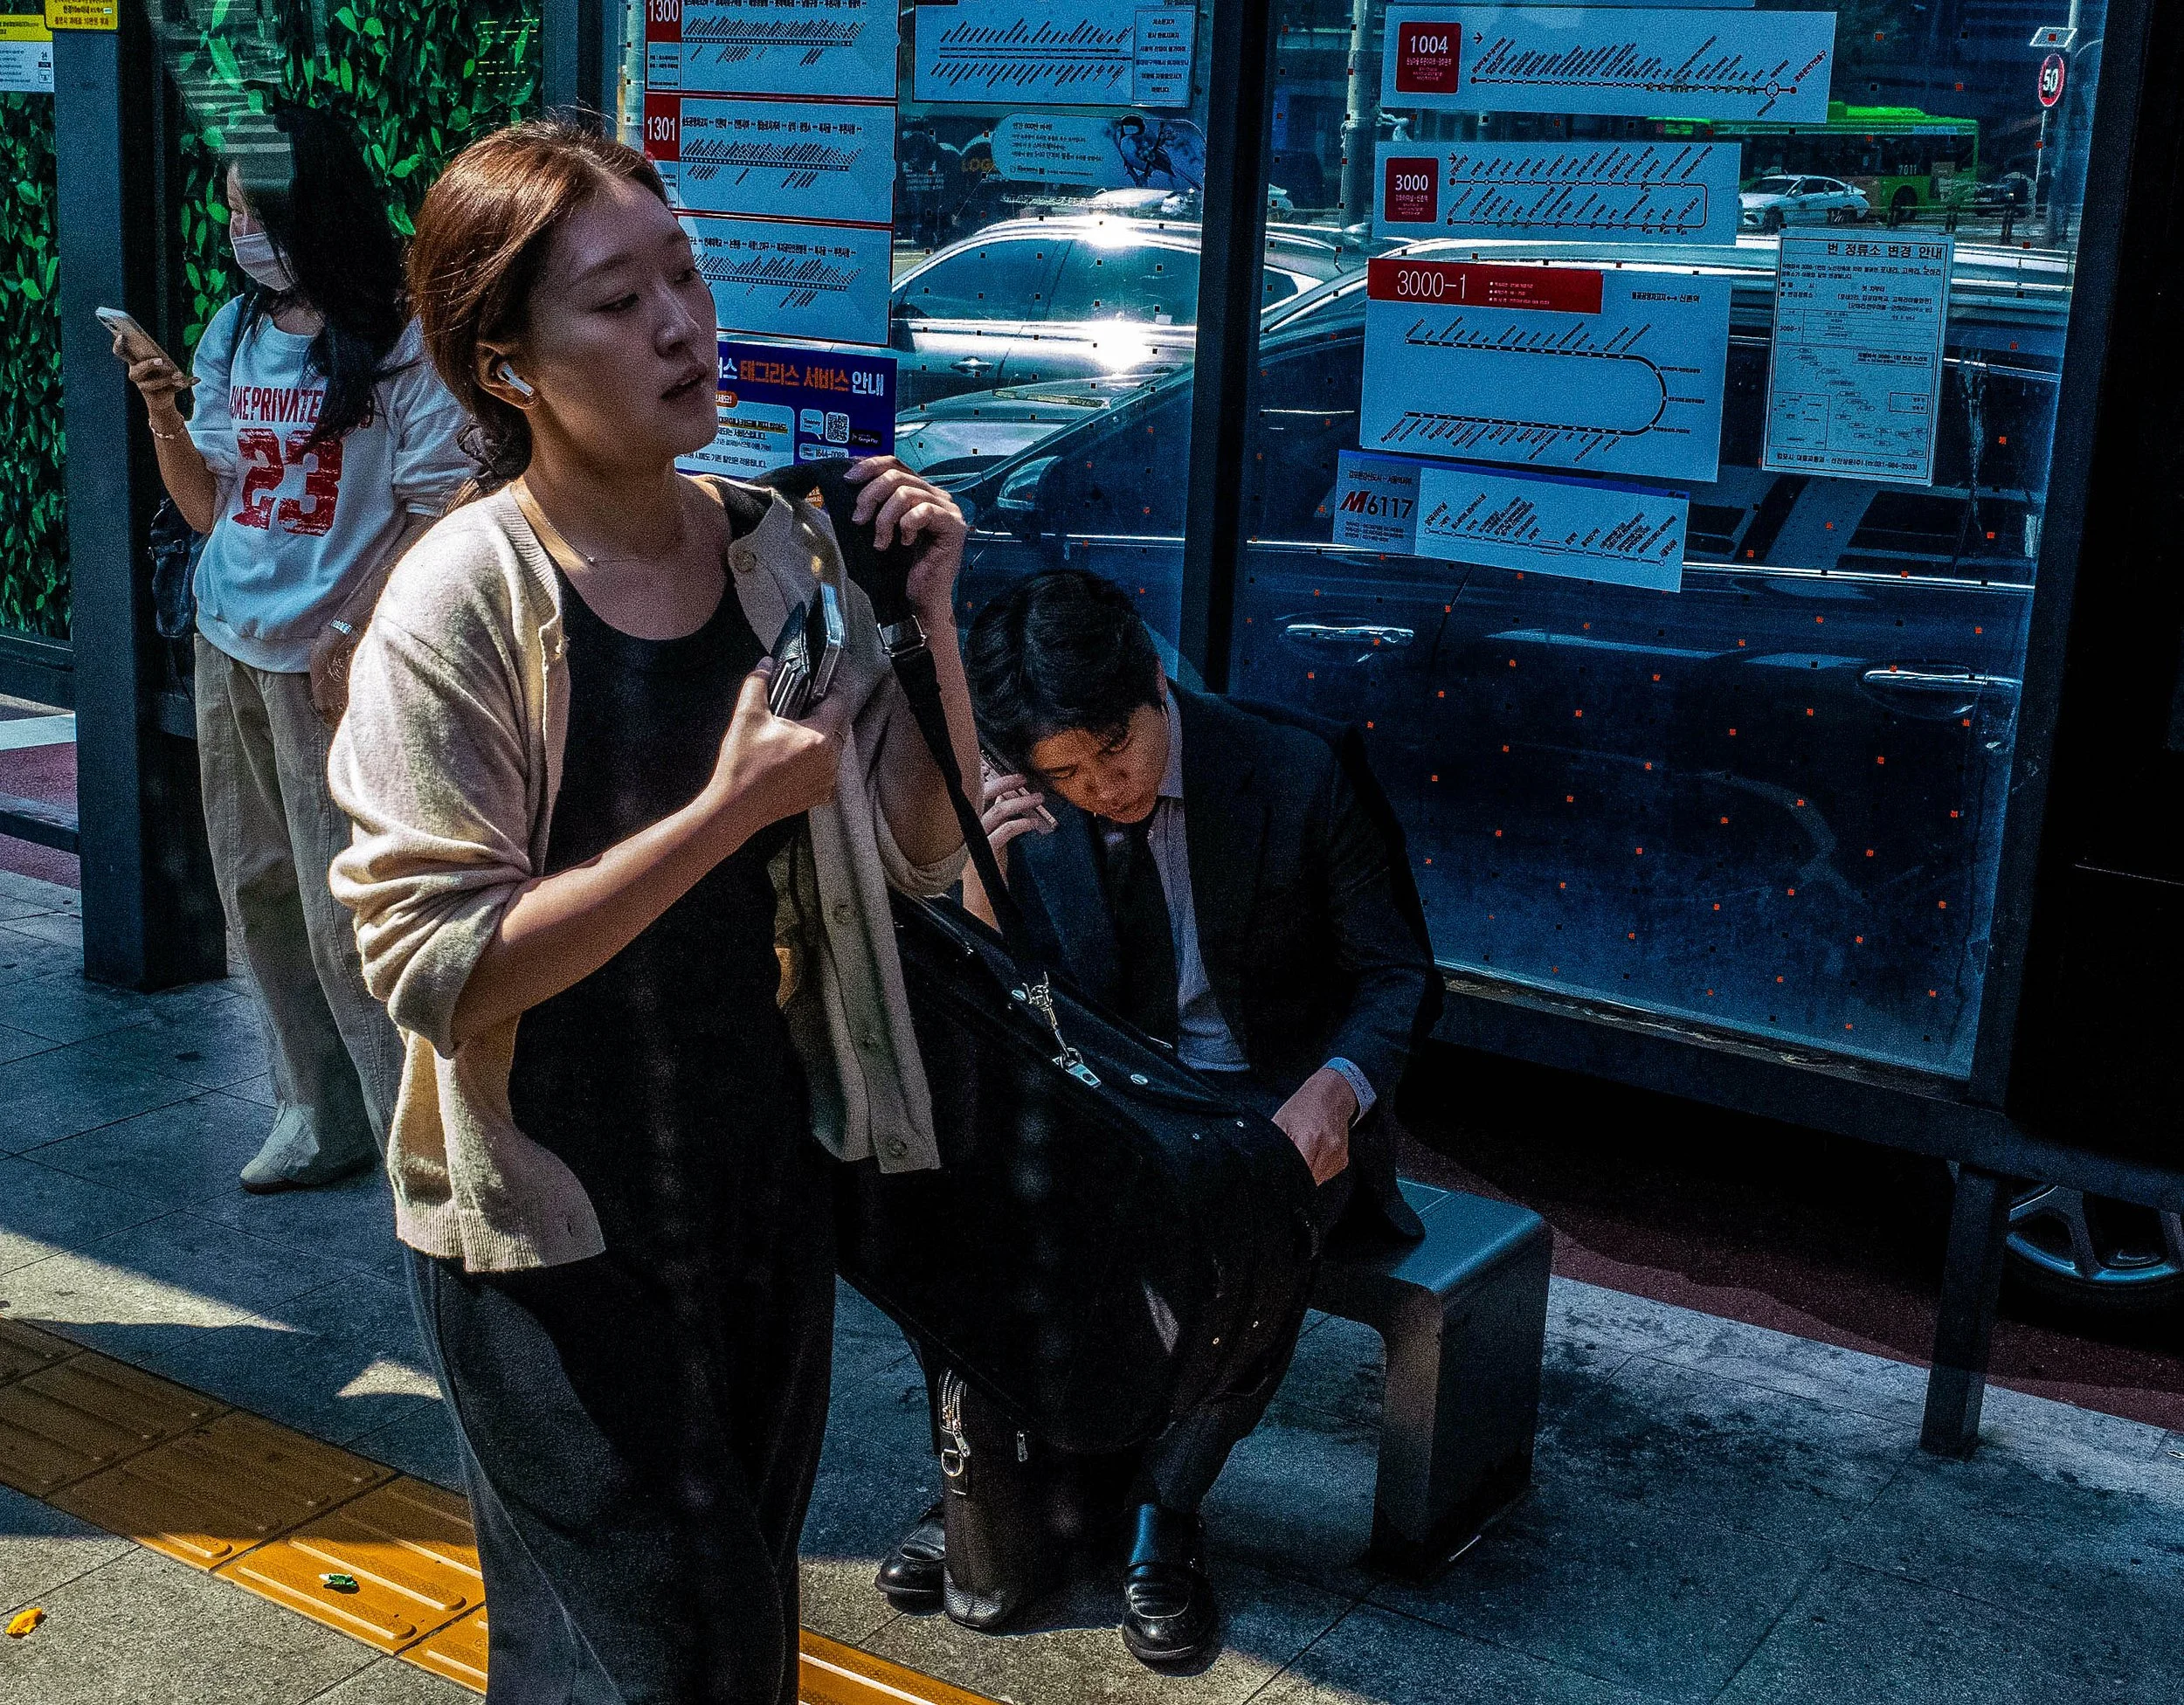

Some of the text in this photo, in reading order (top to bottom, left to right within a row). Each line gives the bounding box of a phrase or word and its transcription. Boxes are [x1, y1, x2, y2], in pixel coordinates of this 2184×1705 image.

[649, 0, 679, 22] 1300
[1410, 35, 1448, 54] 1004
[2042, 68, 2059, 93] 50
[647, 116, 675, 142] 1301
[1395, 174, 1429, 191] 3000
[1898, 164, 1917, 176] 7011
[1828, 242, 1943, 259] 번 정류소 변경 안내
[1397, 270, 1467, 299] 3000-1
[740, 359, 800, 387] 태그리스
[804, 366, 850, 392] 서비스
[852, 370, 884, 397] 안내
[232, 427, 343, 537] 23
[1339, 490, 1414, 520] M6117
